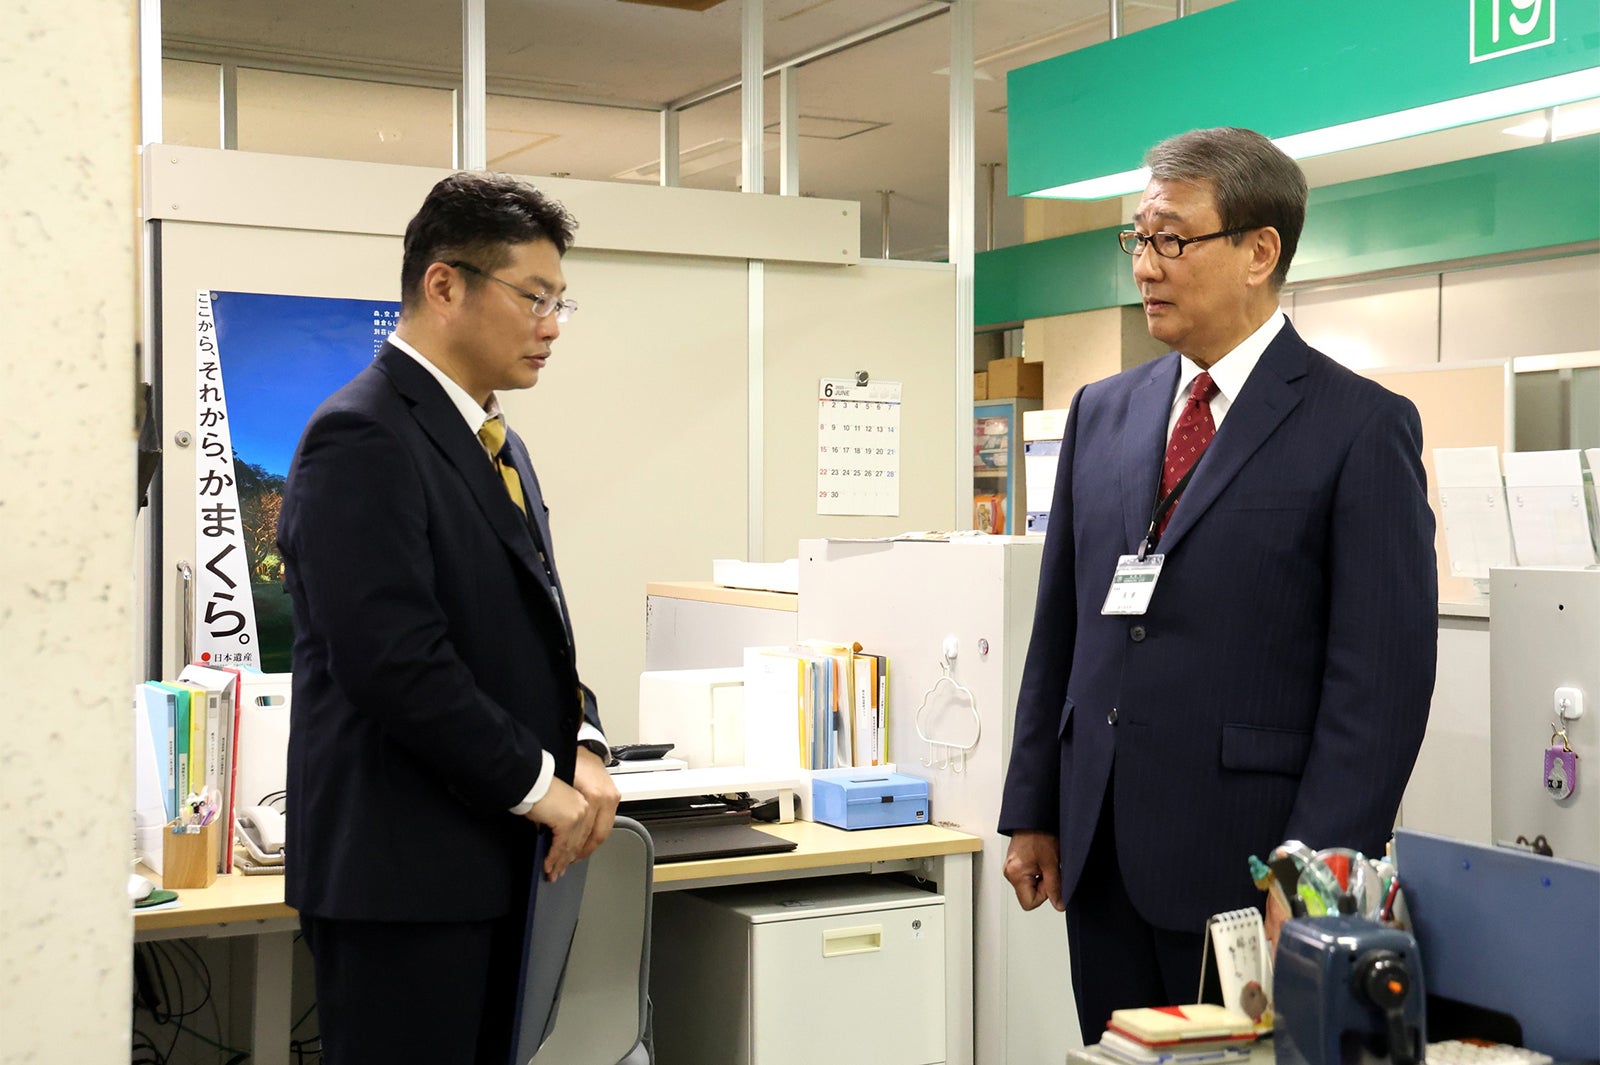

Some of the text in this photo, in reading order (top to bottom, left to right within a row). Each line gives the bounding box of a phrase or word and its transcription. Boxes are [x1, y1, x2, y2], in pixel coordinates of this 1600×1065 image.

[1492, 0, 1542, 43] 19
[824, 383, 833, 398] 6
[198, 293, 250, 645] ここから、それから、かまくら。
[214, 652, 252, 662] 日本遺産
